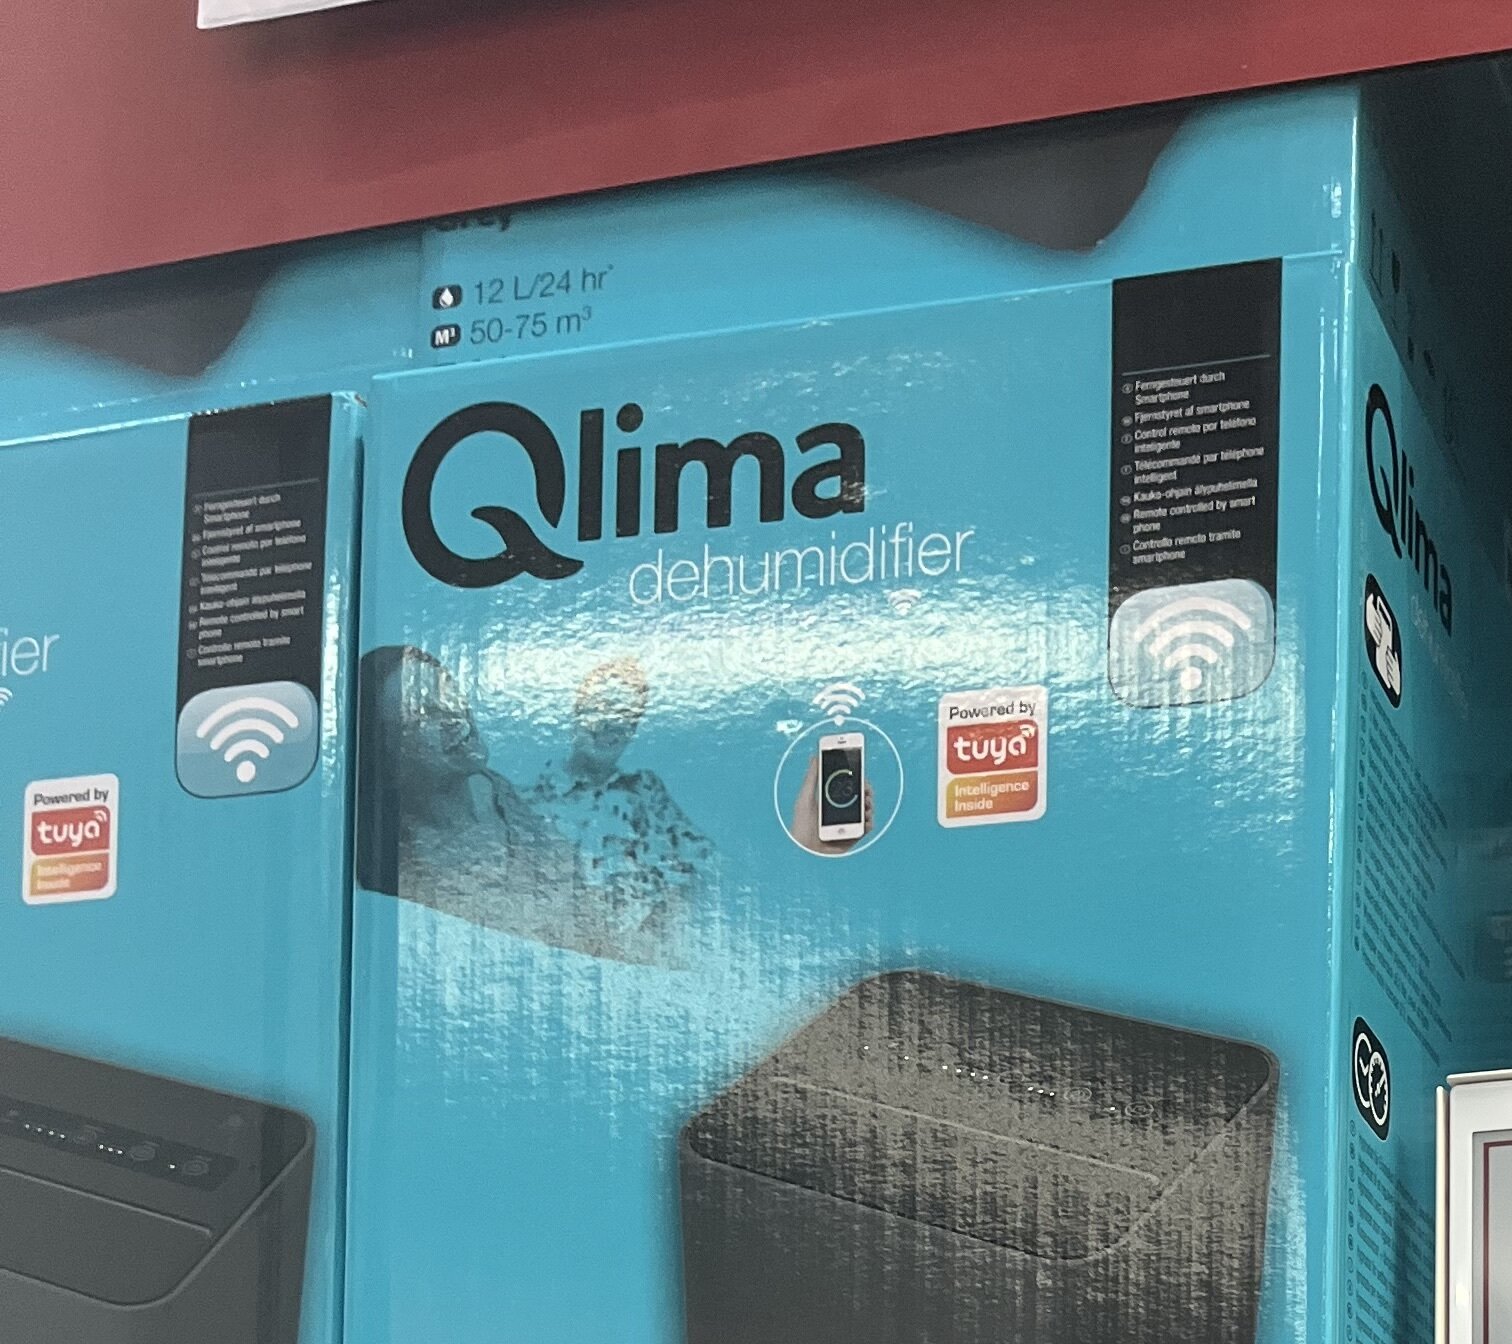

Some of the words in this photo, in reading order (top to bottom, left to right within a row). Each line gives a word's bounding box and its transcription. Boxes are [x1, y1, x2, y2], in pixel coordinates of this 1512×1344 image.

[474, 278, 504, 305] 12
[514, 269, 570, 300] L/24
[470, 312, 548, 345] 50-75
[556, 305, 592, 334] m³
[402, 401, 866, 588] Qlima
[1365, 383, 1452, 639] Qlima
[629, 523, 975, 606] dehumidifier
[949, 702, 1014, 720] Powered
[1020, 701, 1036, 716] by
[953, 736, 1026, 765] tuya
[34, 789, 90, 806] Powered
[94, 787, 109, 804] by
[955, 781, 1030, 797] Intelligence
[955, 798, 993, 812] Inside
[36, 816, 100, 848] tuya
